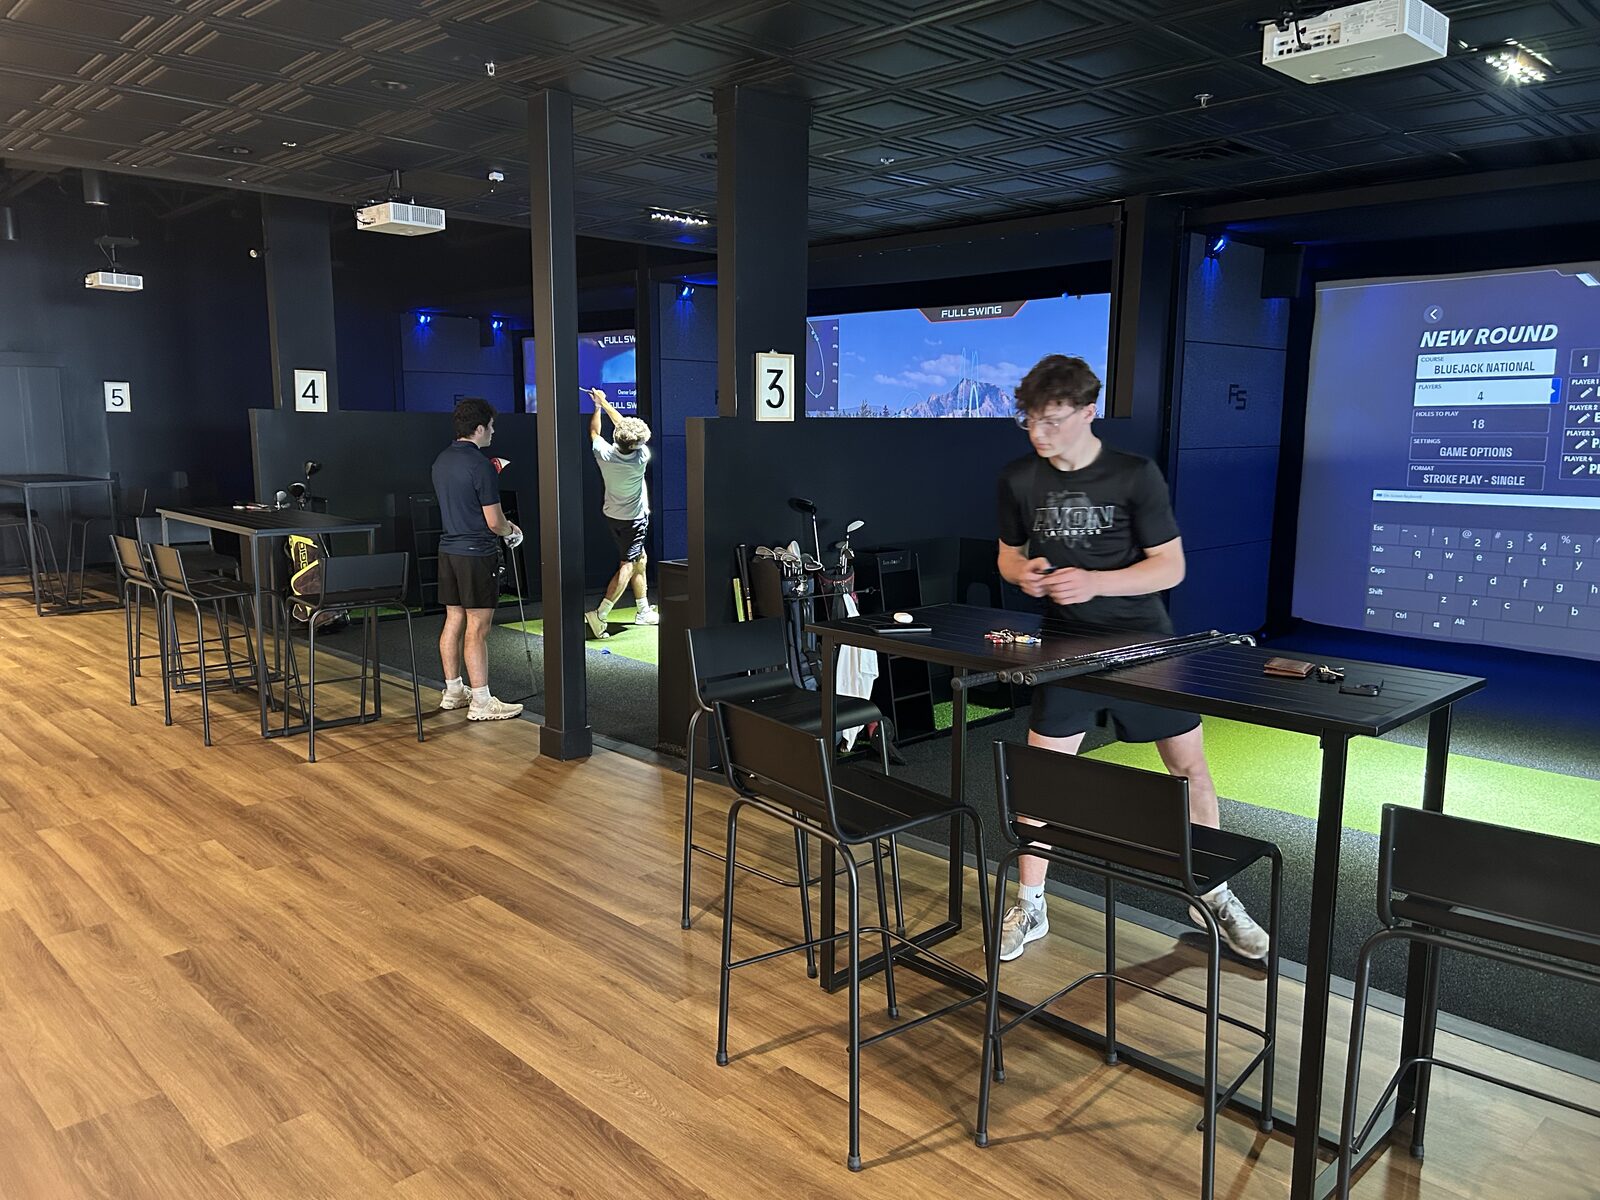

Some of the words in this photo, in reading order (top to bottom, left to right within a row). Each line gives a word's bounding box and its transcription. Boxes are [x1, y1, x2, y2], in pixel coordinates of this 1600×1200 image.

[941, 308, 967, 318] FULL
[968, 305, 1002, 316] SWING
[604, 335, 623, 344] FULL
[1420, 328, 1474, 348] NEW
[1474, 324, 1558, 345] ROUND
[1434, 363, 1483, 375] BLUEJACK
[1486, 361, 1535, 373] NATIONAL
[1582, 355, 1588, 367] 1
[301, 379, 319, 404] 4
[765, 368, 785, 409] 3
[1477, 391, 1484, 400] 4
[111, 388, 124, 407] 5
[1471, 419, 1485, 429] 18
[1439, 447, 1467, 457] GAME
[1470, 447, 1513, 457] OPTIONS
[1423, 474, 1457, 484] STROKE
[1459, 475, 1482, 485] PLAY
[1491, 476, 1525, 486] SINGLE
[1044, 528, 1102, 538] LACROSSE
[1443, 536, 1449, 545] 1
[1474, 538, 1481, 547] 2
[1506, 540, 1513, 549] 3
[1540, 542, 1547, 551] 4
[1574, 544, 1581, 553] 5
[1414, 550, 1421, 558] q
[1541, 557, 1547, 566] t
[1575, 561, 1583, 570] y
[1370, 566, 1386, 574] Caps
[1489, 577, 1497, 585] d
[1522, 578, 1528, 588] f
[1555, 583, 1563, 593] g
[1591, 584, 1598, 594] h
[1368, 587, 1383, 595] Shift
[1571, 606, 1579, 616] b
